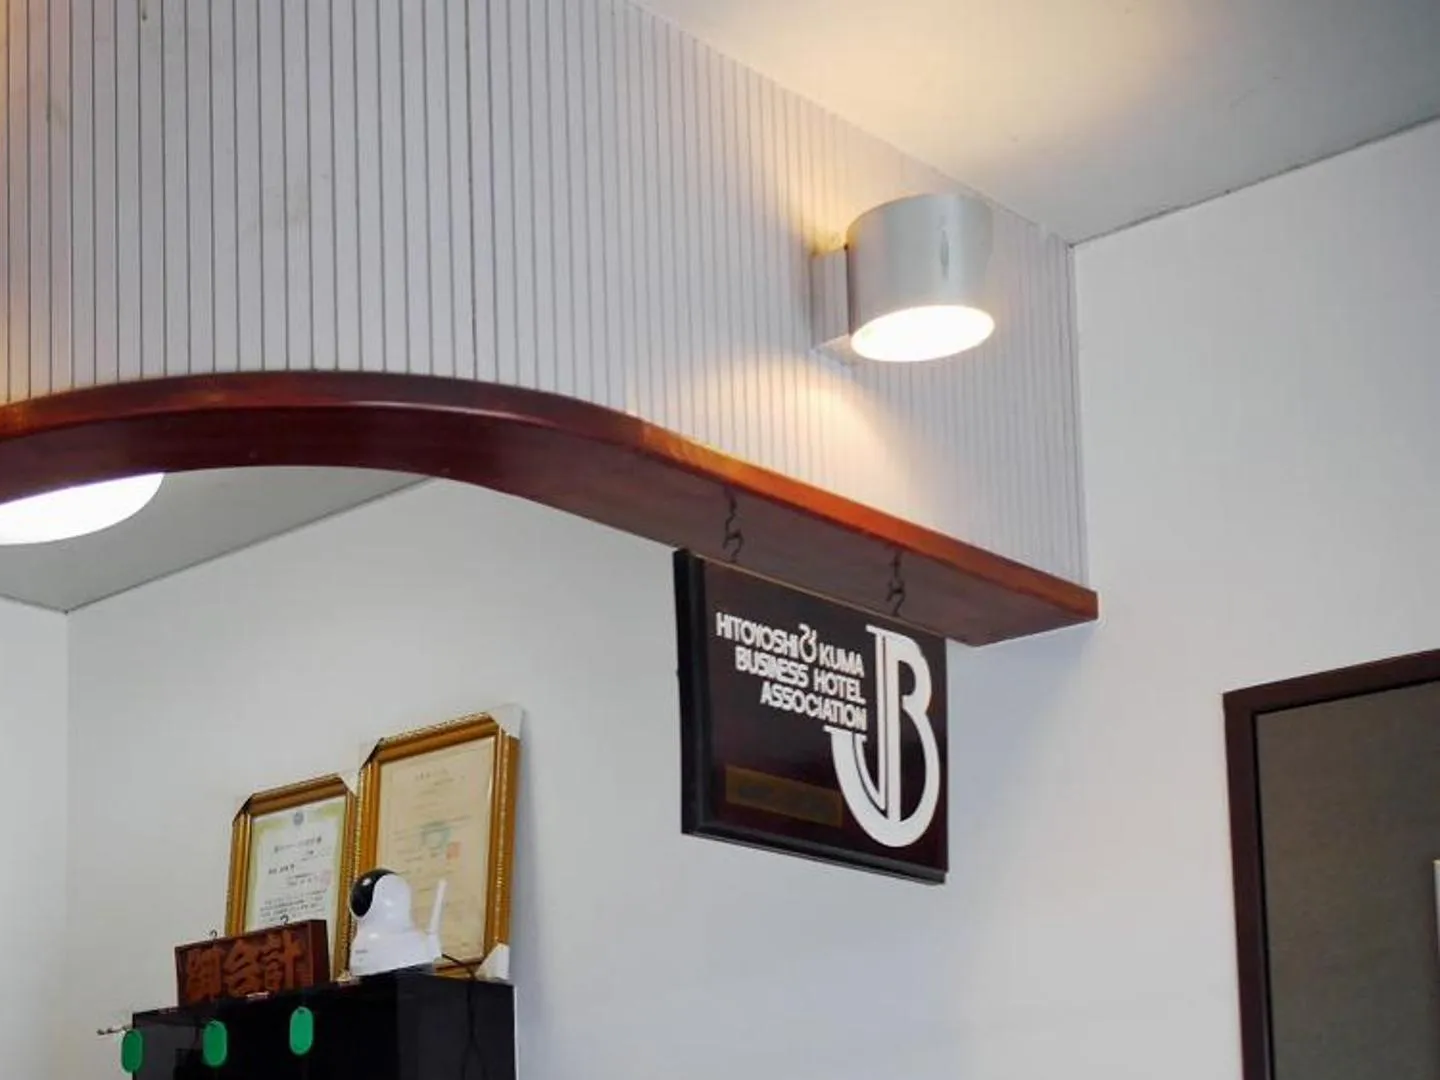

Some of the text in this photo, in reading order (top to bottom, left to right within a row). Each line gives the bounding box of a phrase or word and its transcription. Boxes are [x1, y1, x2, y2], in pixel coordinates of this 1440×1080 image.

[715, 611, 799, 660] HITOYOSHI
[818, 642, 864, 678] KUMA
[734, 644, 866, 705] BUSINESS HOTEL
[760, 681, 867, 731] ASSOCIATION
